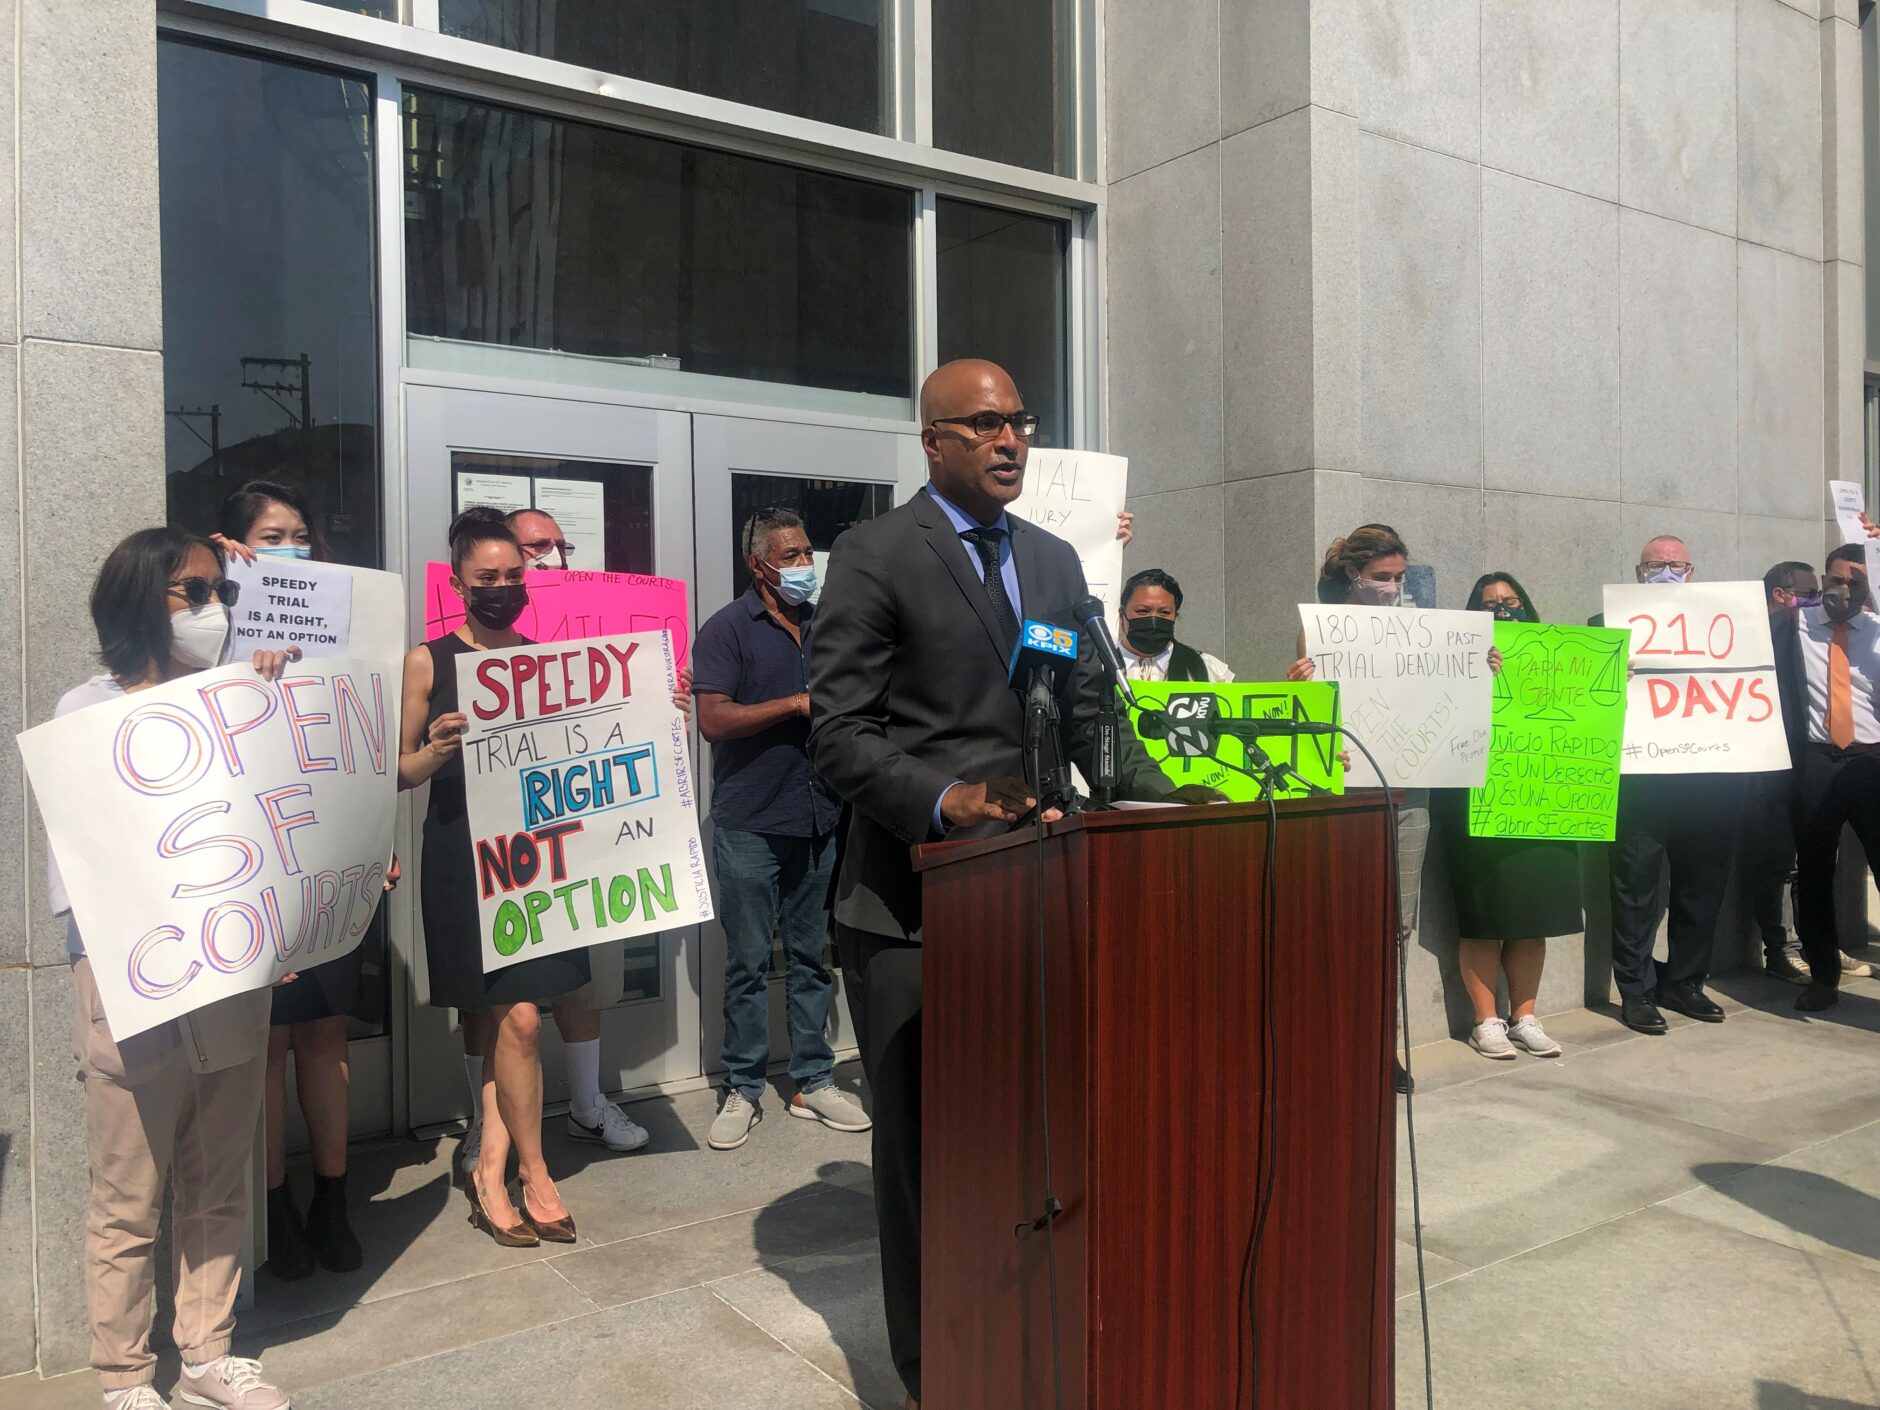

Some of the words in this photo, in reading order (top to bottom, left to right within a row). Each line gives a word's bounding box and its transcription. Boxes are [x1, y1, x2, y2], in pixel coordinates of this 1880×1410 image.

[1036, 459, 1092, 501] IAL
[262, 576, 317, 591] SPEEDY
[564, 571, 594, 582] OPEN
[600, 573, 620, 584] THE
[268, 595, 309, 608] TRIAL
[237, 627, 263, 638] NOT
[267, 631, 284, 640] AN
[289, 632, 337, 644] OPTION
[248, 611, 262, 622] IS
[266, 613, 275, 623] A
[280, 614, 328, 629] RIGHT,
[1315, 614, 1358, 645] 180
[1371, 614, 1433, 648] DAYS
[1446, 630, 1482, 646] PAST
[1628, 613, 1734, 659] 210
[1028, 638, 1072, 655] KPIX
[1053, 628, 1073, 648] 5
[472, 642, 640, 720] SPEEDY
[1316, 651, 1382, 679] TRIAL
[1395, 652, 1479, 679] DEADLINE
[1516, 652, 1564, 677] PARA
[1196, 697, 1211, 719] KTVU
[1519, 678, 1587, 707] GENTE
[1647, 675, 1773, 722] DAYS
[113, 673, 387, 796] OPEN
[466, 731, 547, 774] TRIAL
[565, 724, 588, 755] IS
[604, 722, 624, 748] A
[1376, 713, 1410, 752] THE
[1549, 725, 1618, 758] RAPIDO
[525, 748, 651, 826] RIGHT
[1472, 778, 1496, 806] NO
[157, 784, 319, 899] SF
[477, 820, 584, 900] NOT
[615, 817, 653, 845] AN
[493, 863, 679, 956] OPTION
[128, 862, 385, 1000] COURTS
